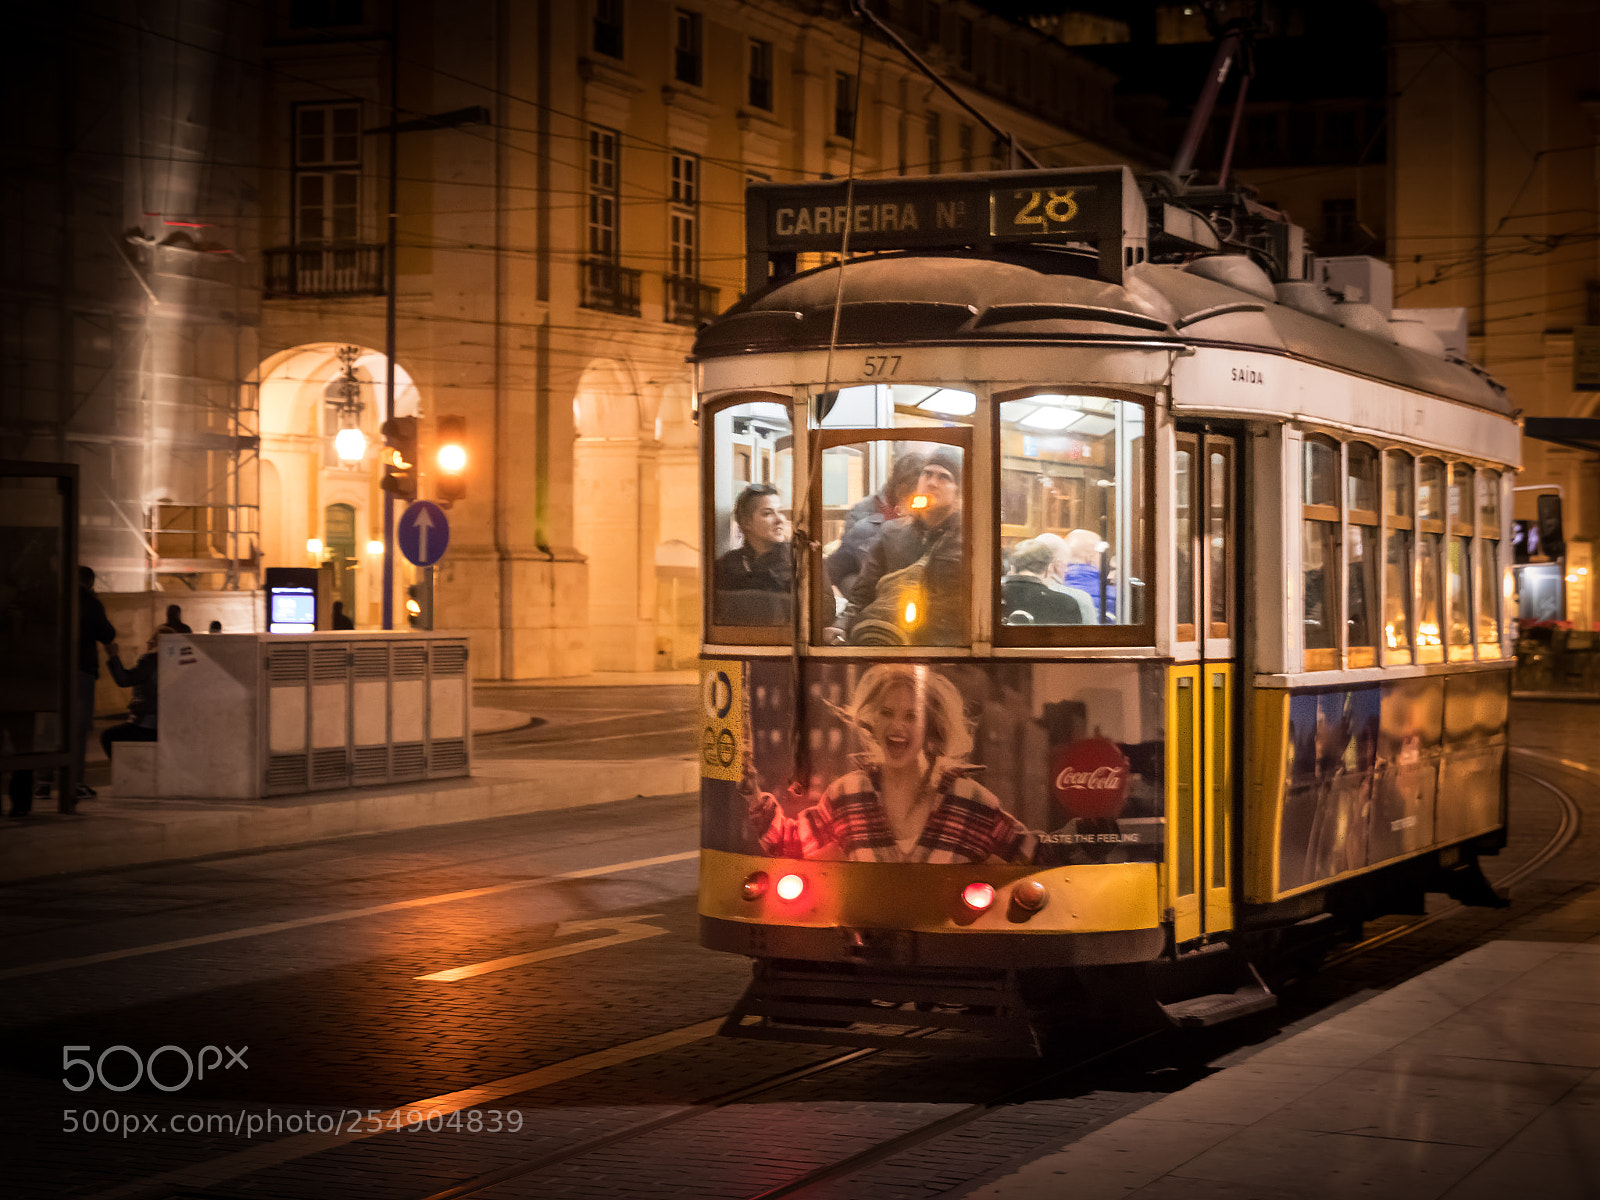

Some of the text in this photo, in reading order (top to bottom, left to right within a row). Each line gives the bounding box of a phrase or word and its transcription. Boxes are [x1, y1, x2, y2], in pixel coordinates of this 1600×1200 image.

[775, 202, 919, 236] CARREIRA
[1013, 190, 1078, 225] 28
[863, 355, 902, 377] 577
[1038, 833, 1140, 844] TASTE THE FEELING
